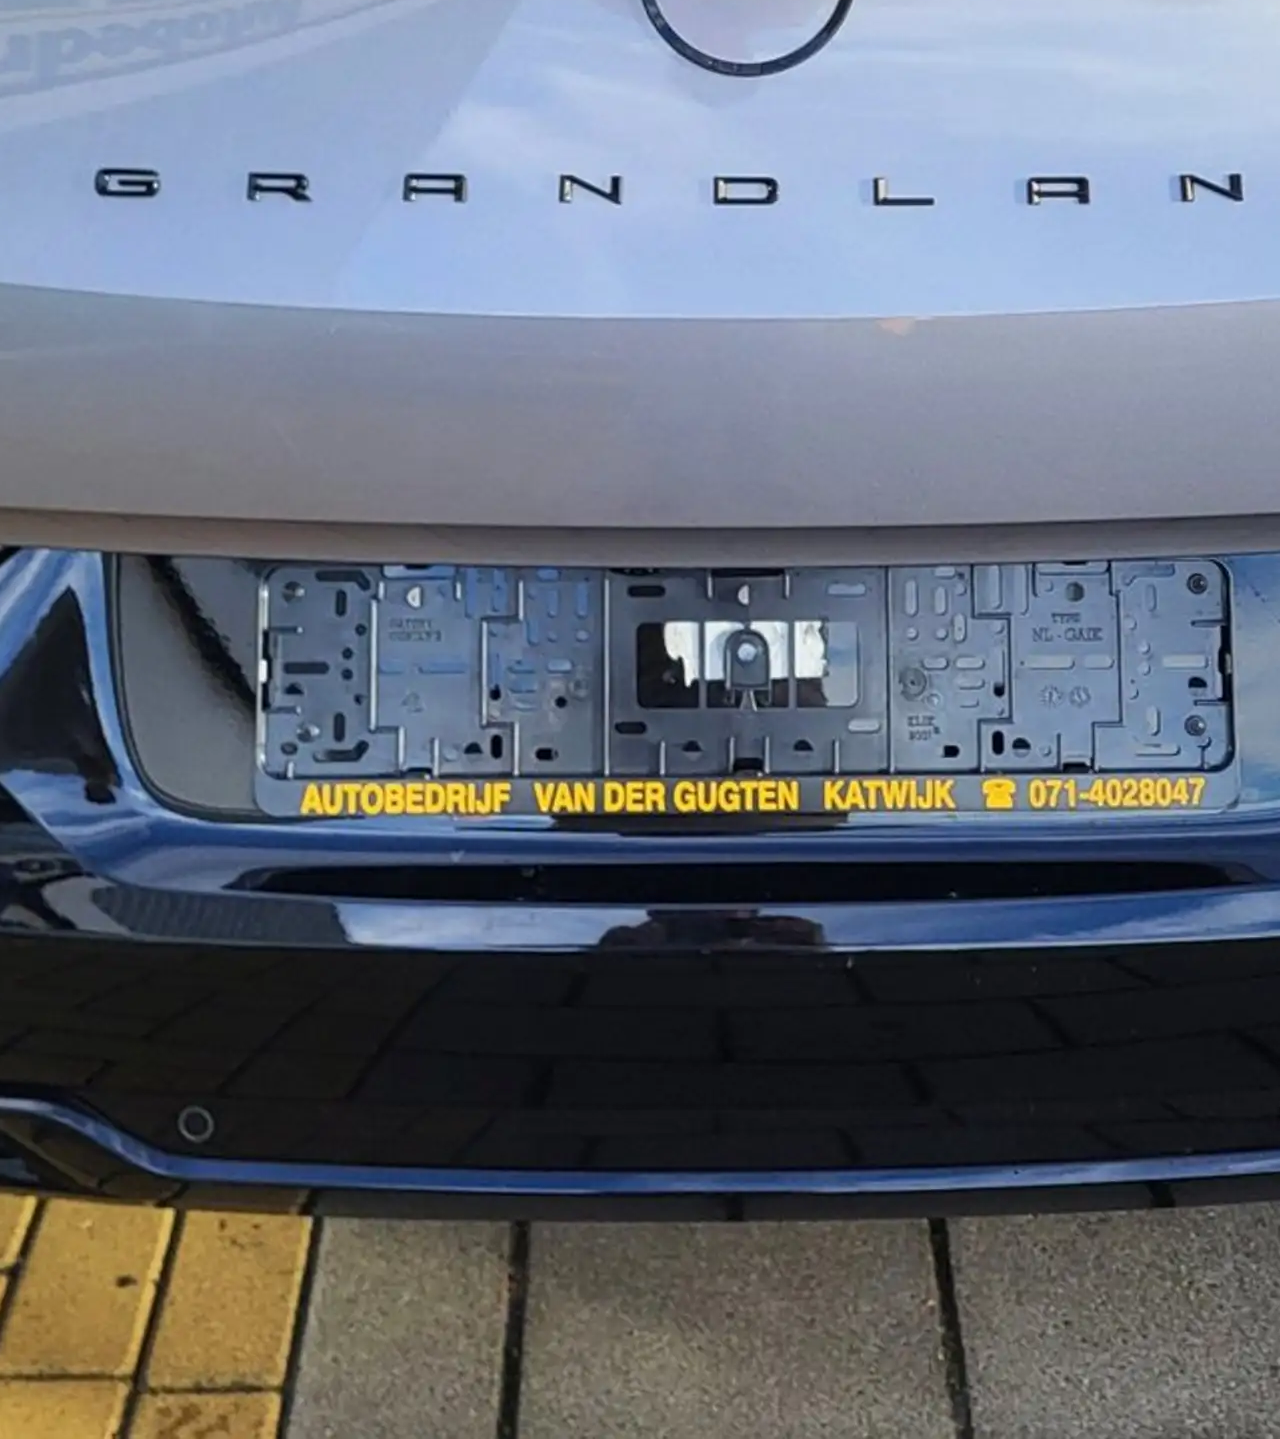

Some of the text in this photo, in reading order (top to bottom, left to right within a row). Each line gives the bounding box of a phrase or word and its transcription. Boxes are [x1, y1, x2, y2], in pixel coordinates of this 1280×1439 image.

[300, 776, 1205, 816] AUTOBEDRIJF VAN DER GUGTEN KATWIJK 071-4028047
